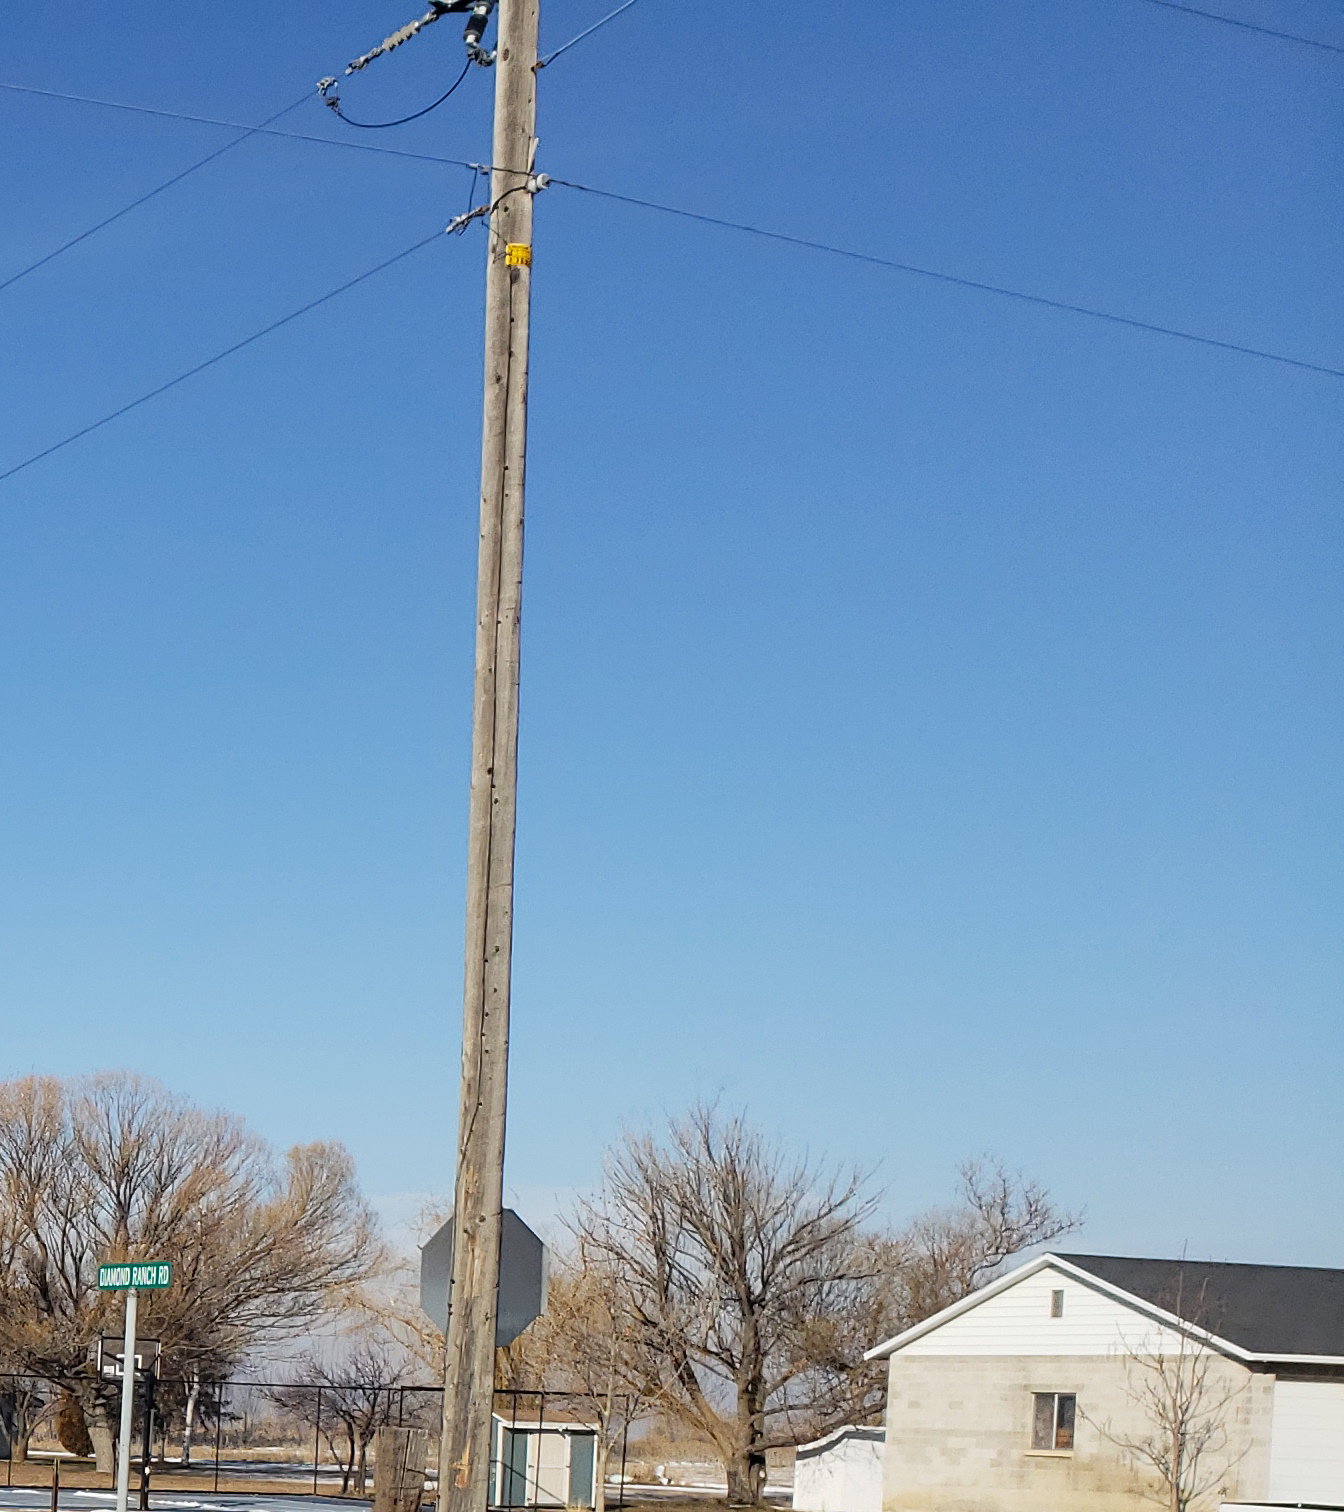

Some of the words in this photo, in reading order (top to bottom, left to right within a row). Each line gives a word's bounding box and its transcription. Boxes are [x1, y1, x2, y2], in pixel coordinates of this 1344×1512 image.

[99, 1267, 131, 1286] DIAMOND
[132, 1266, 157, 1285] RANCH
[158, 1265, 169, 1284] RD
